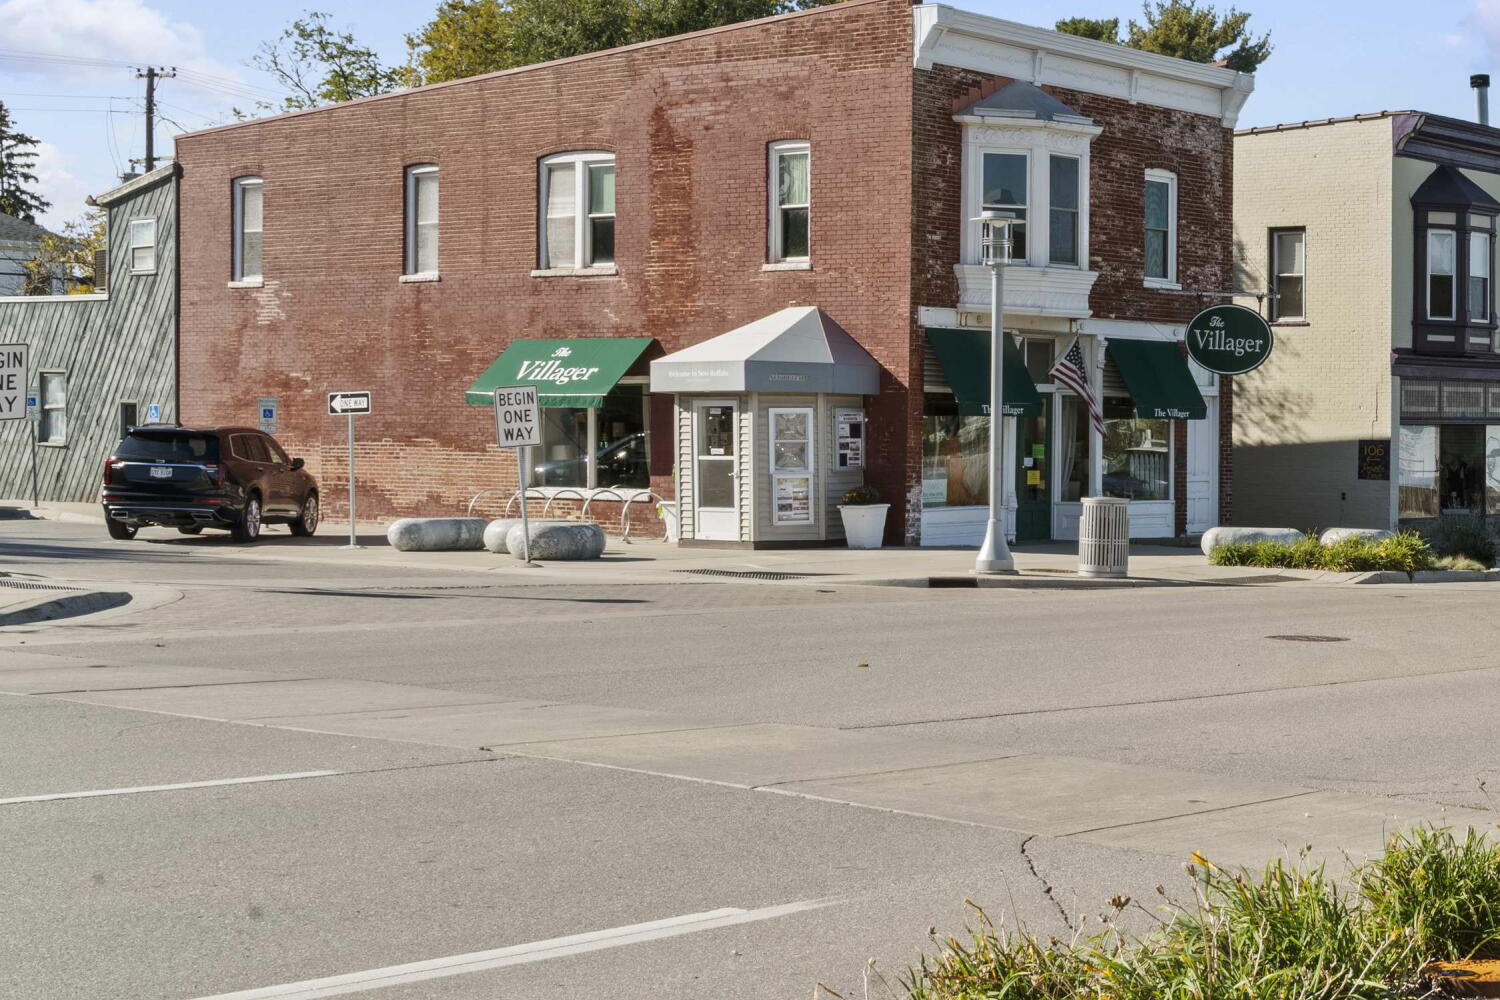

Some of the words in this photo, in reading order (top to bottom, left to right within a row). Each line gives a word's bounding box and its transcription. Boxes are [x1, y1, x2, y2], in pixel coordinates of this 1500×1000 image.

[1210, 316, 1225, 327] The
[1194, 329, 1263, 356] Villager
[552, 347, 572, 357] The
[516, 360, 599, 385] Villager
[340, 399, 352, 408] ONE
[354, 399, 366, 407] WAY
[499, 392, 534, 406] BEGIN
[1001, 405, 1024, 415] illager
[1154, 408, 1166, 417] The
[1167, 408, 1190, 418] Villager
[504, 410, 532, 423] ONE
[504, 427, 533, 442] WAY
